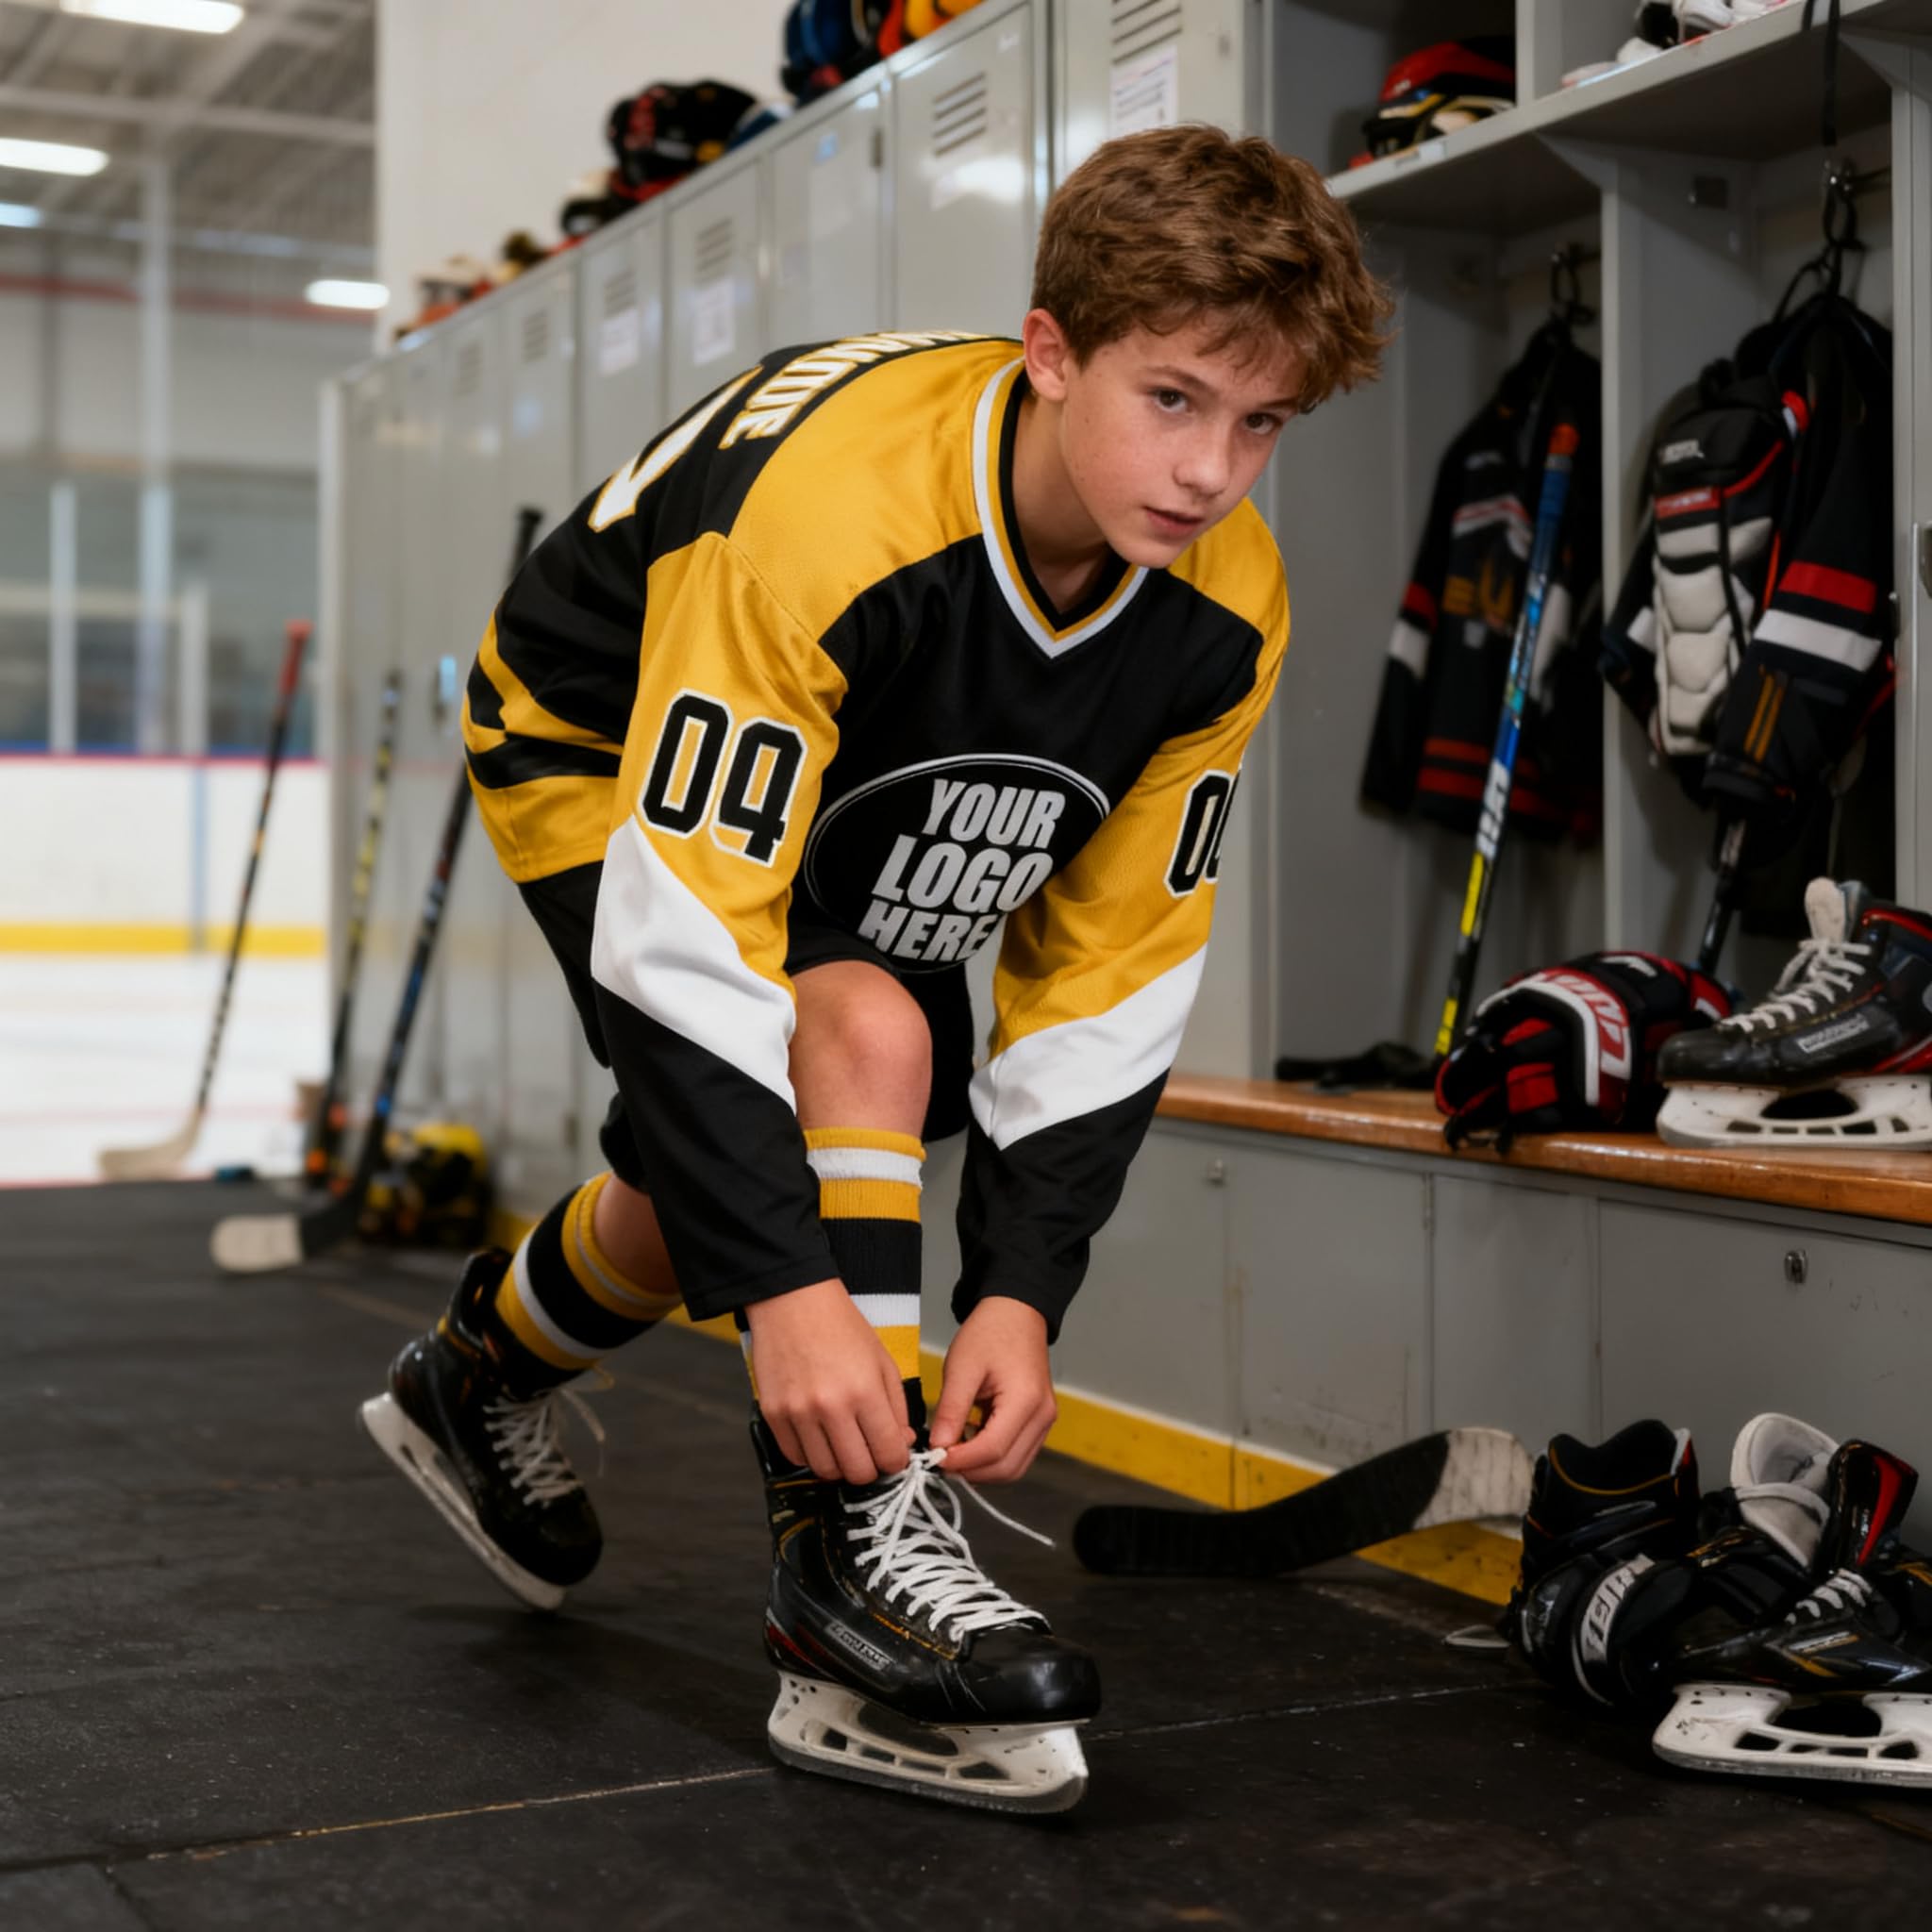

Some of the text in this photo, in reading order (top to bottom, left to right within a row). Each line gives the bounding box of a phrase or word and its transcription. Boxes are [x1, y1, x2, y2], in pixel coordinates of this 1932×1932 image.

[922, 778, 1065, 849] YOUR
[872, 834, 1054, 913] LOGO
[858, 899, 998, 962] HERE
